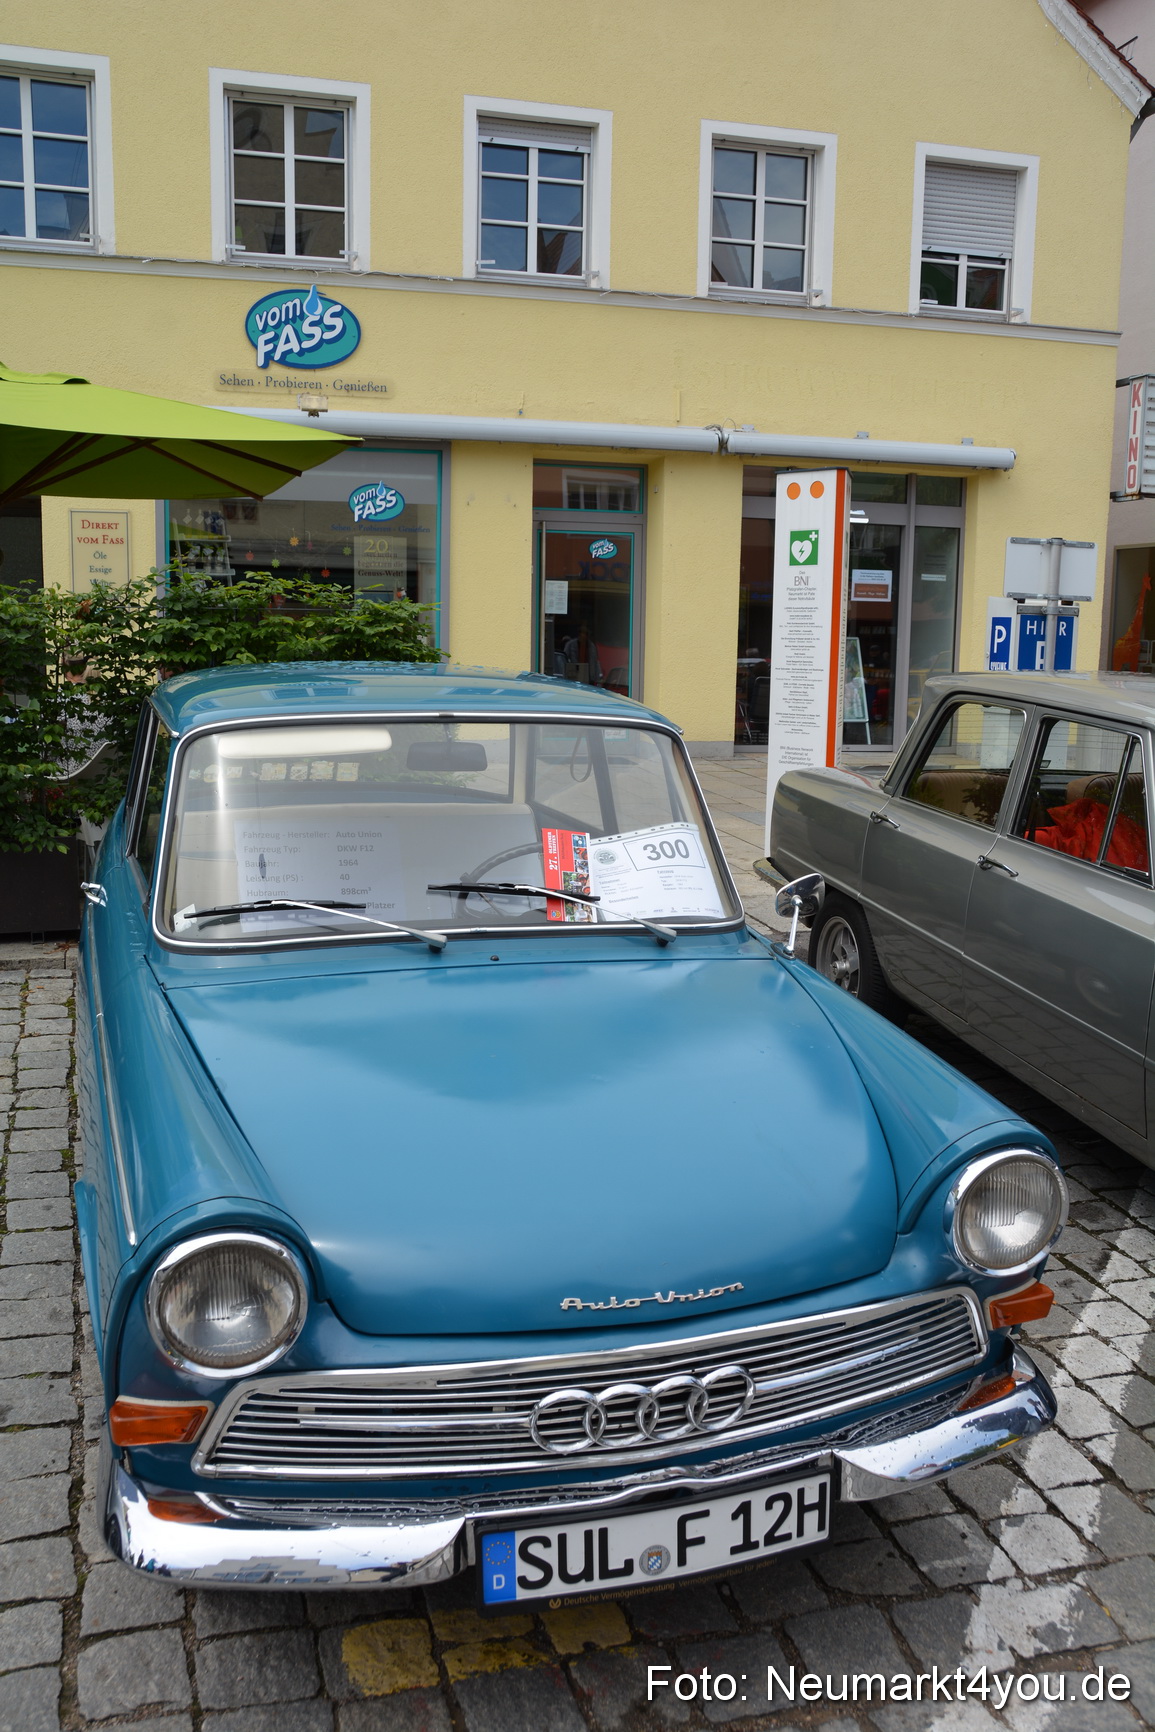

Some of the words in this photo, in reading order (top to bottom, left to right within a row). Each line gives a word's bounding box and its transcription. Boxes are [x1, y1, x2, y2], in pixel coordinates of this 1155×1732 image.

[255, 298, 300, 331] vom
[257, 304, 344, 367] FASS
[219, 374, 254, 386] Sehen
[265, 376, 322, 389] Probieren
[333, 379, 387, 393] Genießen
[1127, 382, 1143, 489] KINO
[353, 487, 376, 505] vom
[354, 490, 396, 522] FASS
[364, 539, 389, 553] 20
[592, 543, 614, 558] FASS
[93, 551, 107, 560] Öle
[89, 565, 112, 575] Essige
[358, 569, 404, 577] Genuss-Welt!
[794, 576, 809, 586] BNI
[1026, 620, 1067, 636] HIR
[993, 625, 1007, 653] P
[243, 831, 280, 840] Fahrzeug
[287, 831, 330, 839] Hersteller:
[244, 846, 281, 854] Fahrzeug
[642, 838, 690, 861] 300
[245, 860, 280, 869] Baujahr:
[549, 856, 558, 870] 27.
[246, 875, 280, 884] Leistung
[282, 874, 299, 883] (PS)
[246, 889, 289, 897] Hubraum:
[560, 1296, 642, 1311] Auto
[655, 1282, 745, 1304] Union
[517, 1527, 634, 1590] SUL
[677, 1509, 711, 1567] F
[729, 1482, 827, 1555] 12H
[492, 1574, 506, 1590] D
[563, 1593, 599, 1607] Deutsche
[600, 1581, 675, 1602] Vermögensberatung
